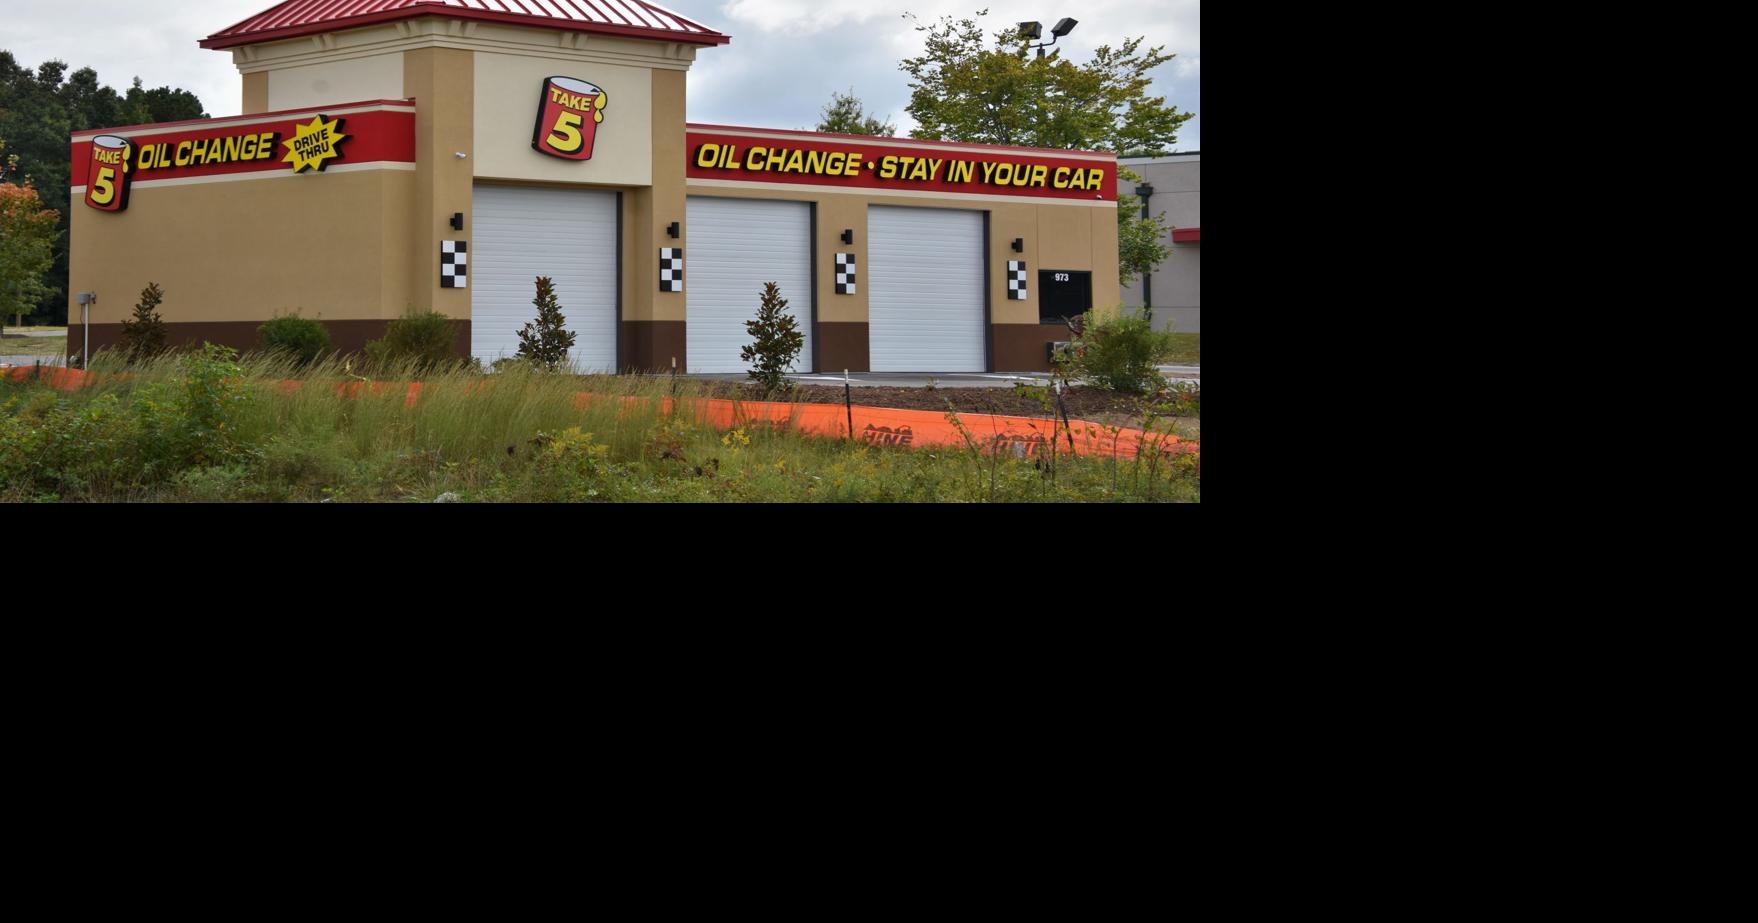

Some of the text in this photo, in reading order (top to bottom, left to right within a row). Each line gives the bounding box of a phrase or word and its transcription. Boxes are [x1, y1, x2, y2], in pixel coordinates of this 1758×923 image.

[550, 87, 592, 112] TAKE
[293, 128, 329, 151] DRIVE
[546, 110, 582, 152] 5
[93, 146, 121, 164] TAKE
[137, 132, 274, 170] OIL CHANGE
[298, 141, 329, 161] THRU
[697, 143, 1105, 191] OIL CHANGE STAY IN YOUR CAR
[90, 166, 115, 205] 5
[1054, 273, 1069, 282] 973
